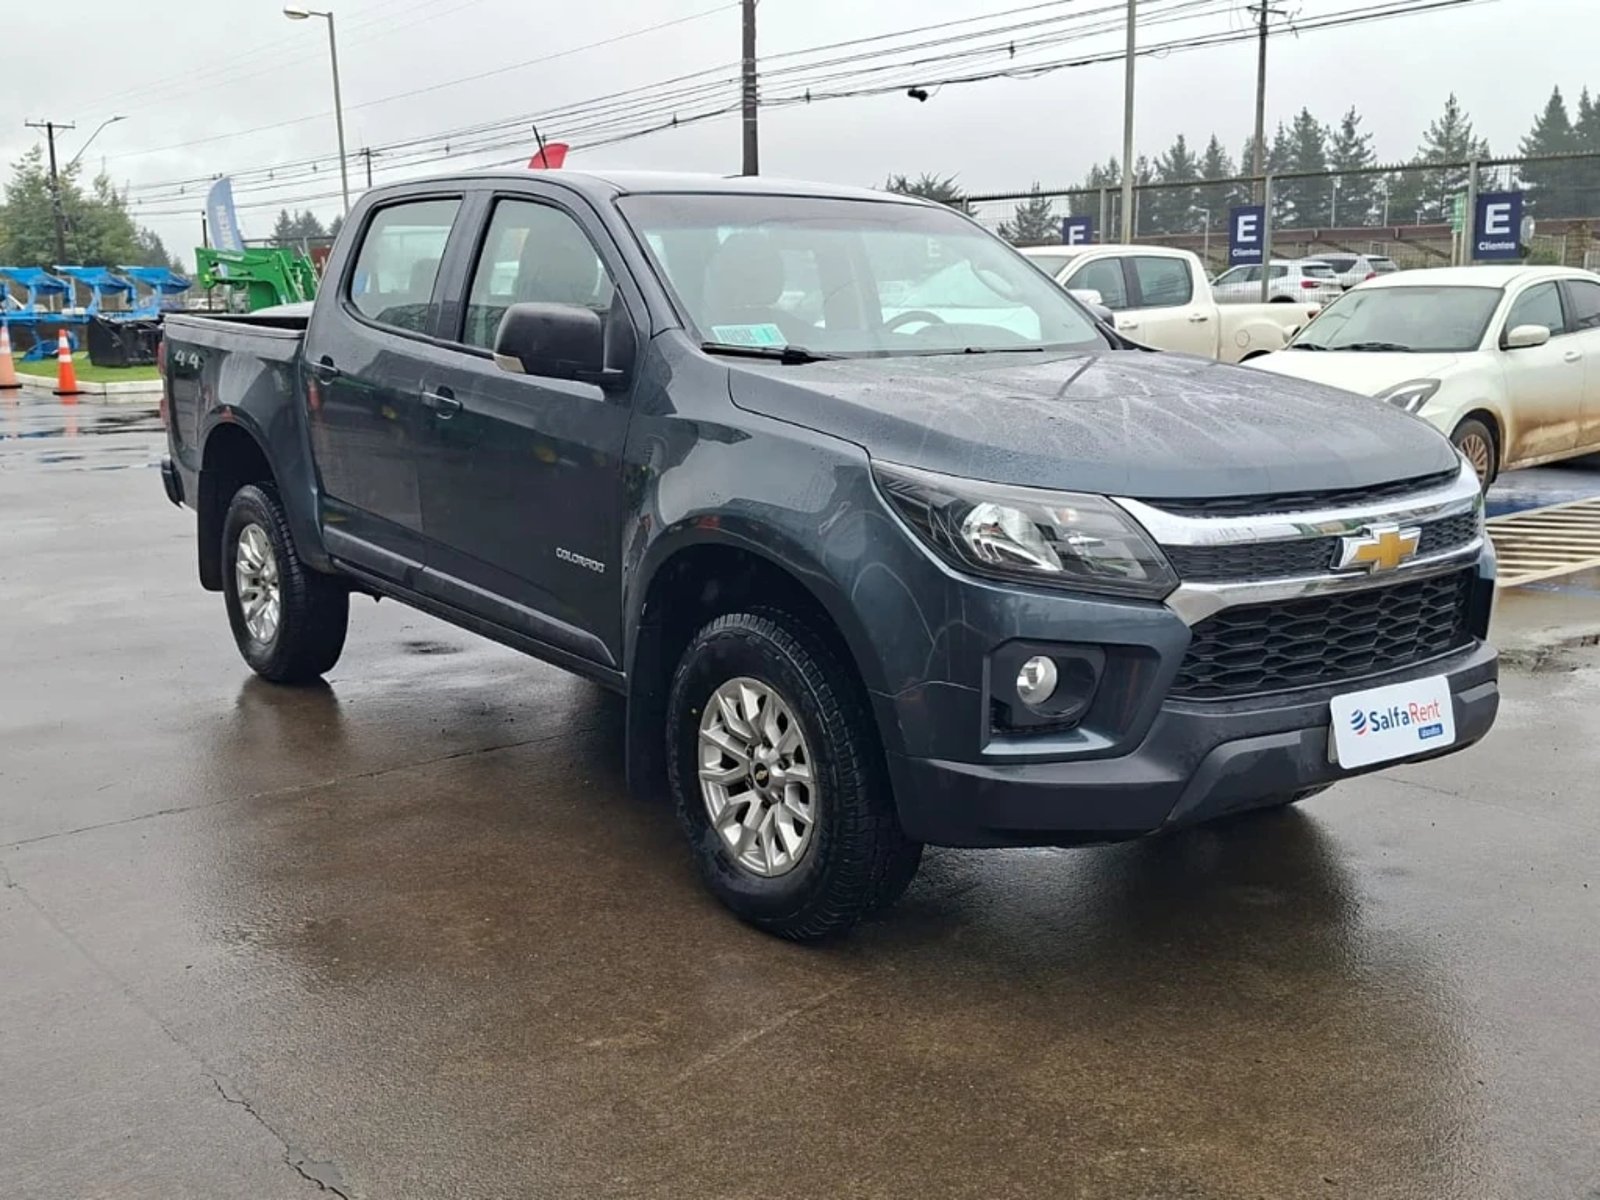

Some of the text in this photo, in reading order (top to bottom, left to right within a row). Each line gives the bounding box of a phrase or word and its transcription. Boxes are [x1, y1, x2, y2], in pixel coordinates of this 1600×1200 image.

[1237, 215, 1257, 242] E
[1485, 203, 1511, 235] E
[555, 547, 605, 573] COLORADO
[1369, 699, 1441, 732] SalfaRent
